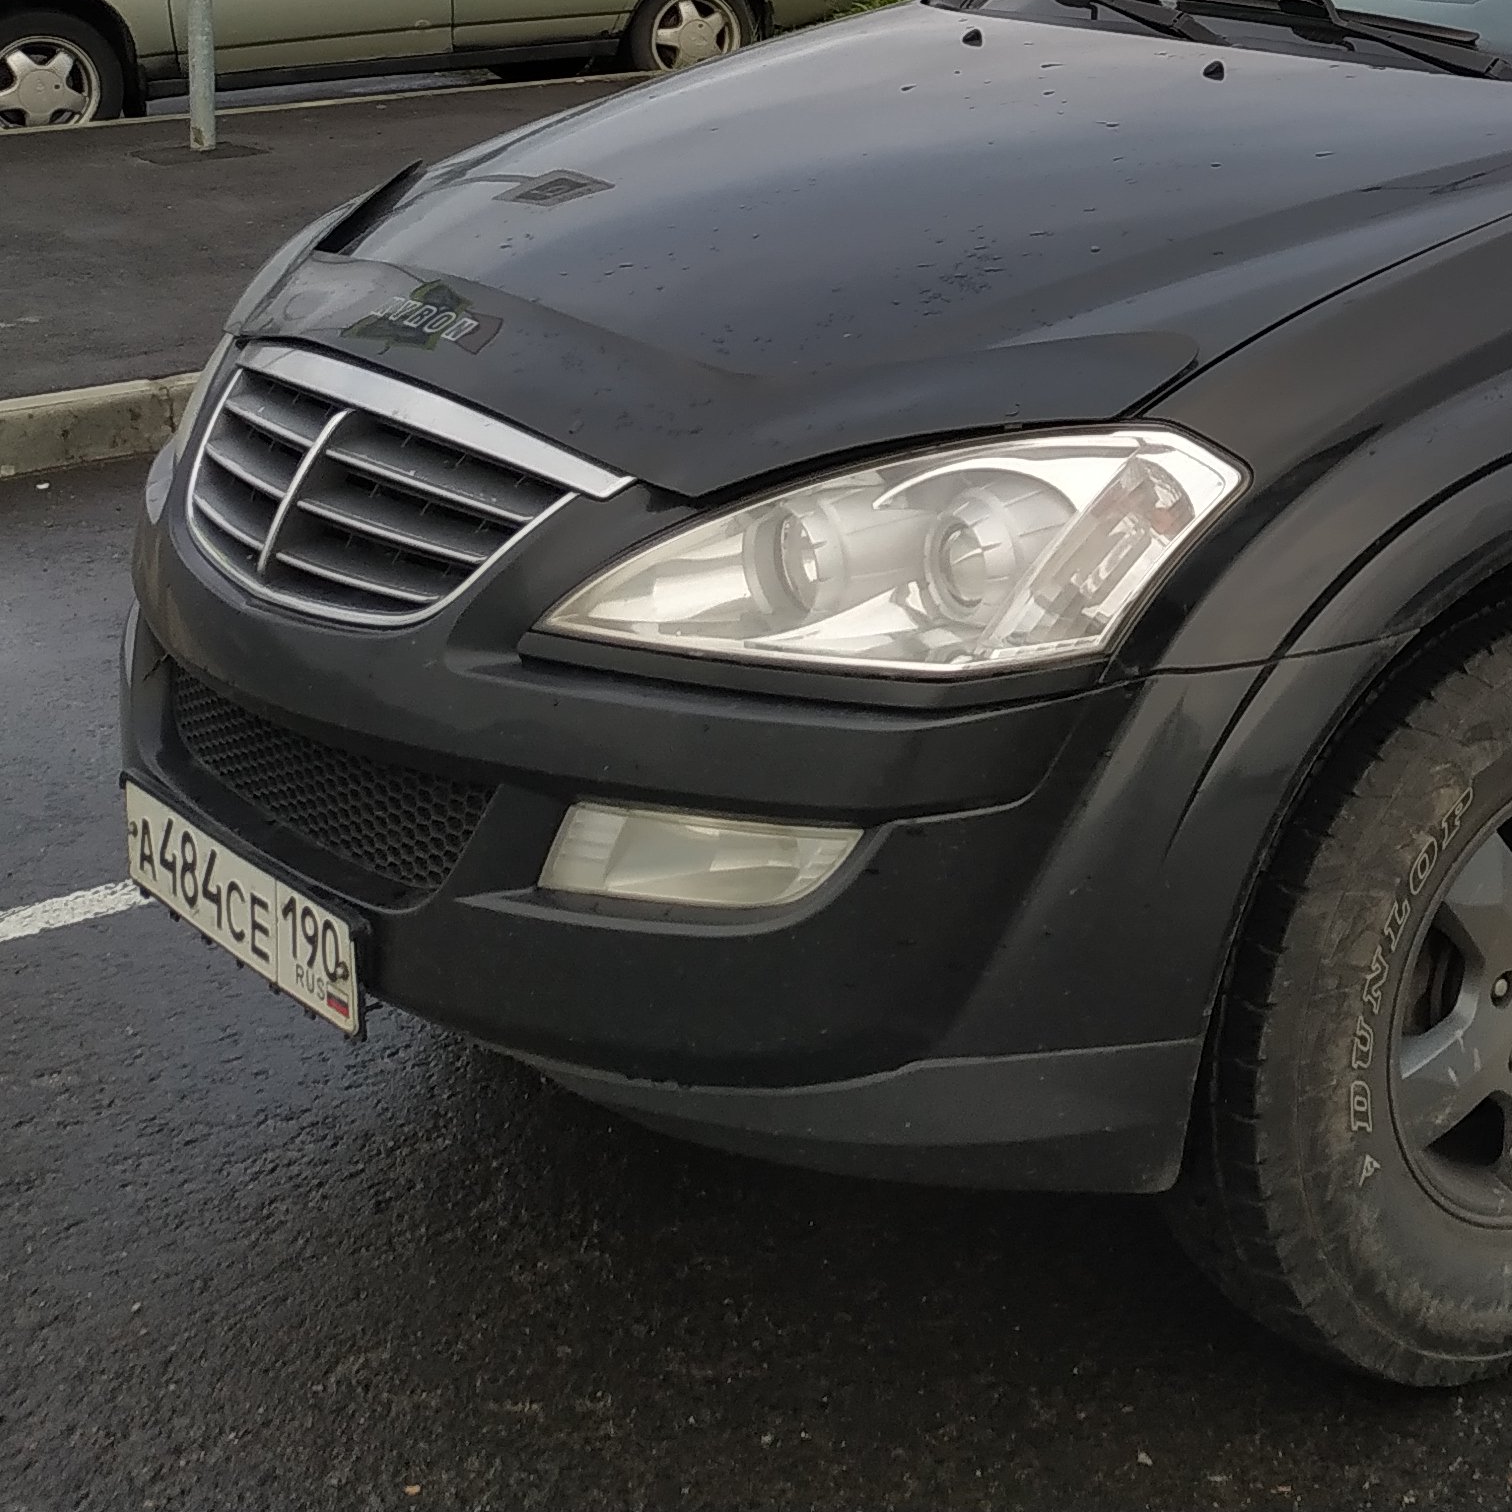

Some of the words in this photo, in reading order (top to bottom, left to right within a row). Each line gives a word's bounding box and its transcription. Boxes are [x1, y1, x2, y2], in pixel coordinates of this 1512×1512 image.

[281, 895, 343, 983] 190
[295, 963, 326, 1002] RUS
[1351, 787, 1474, 1133] DUNLOP
